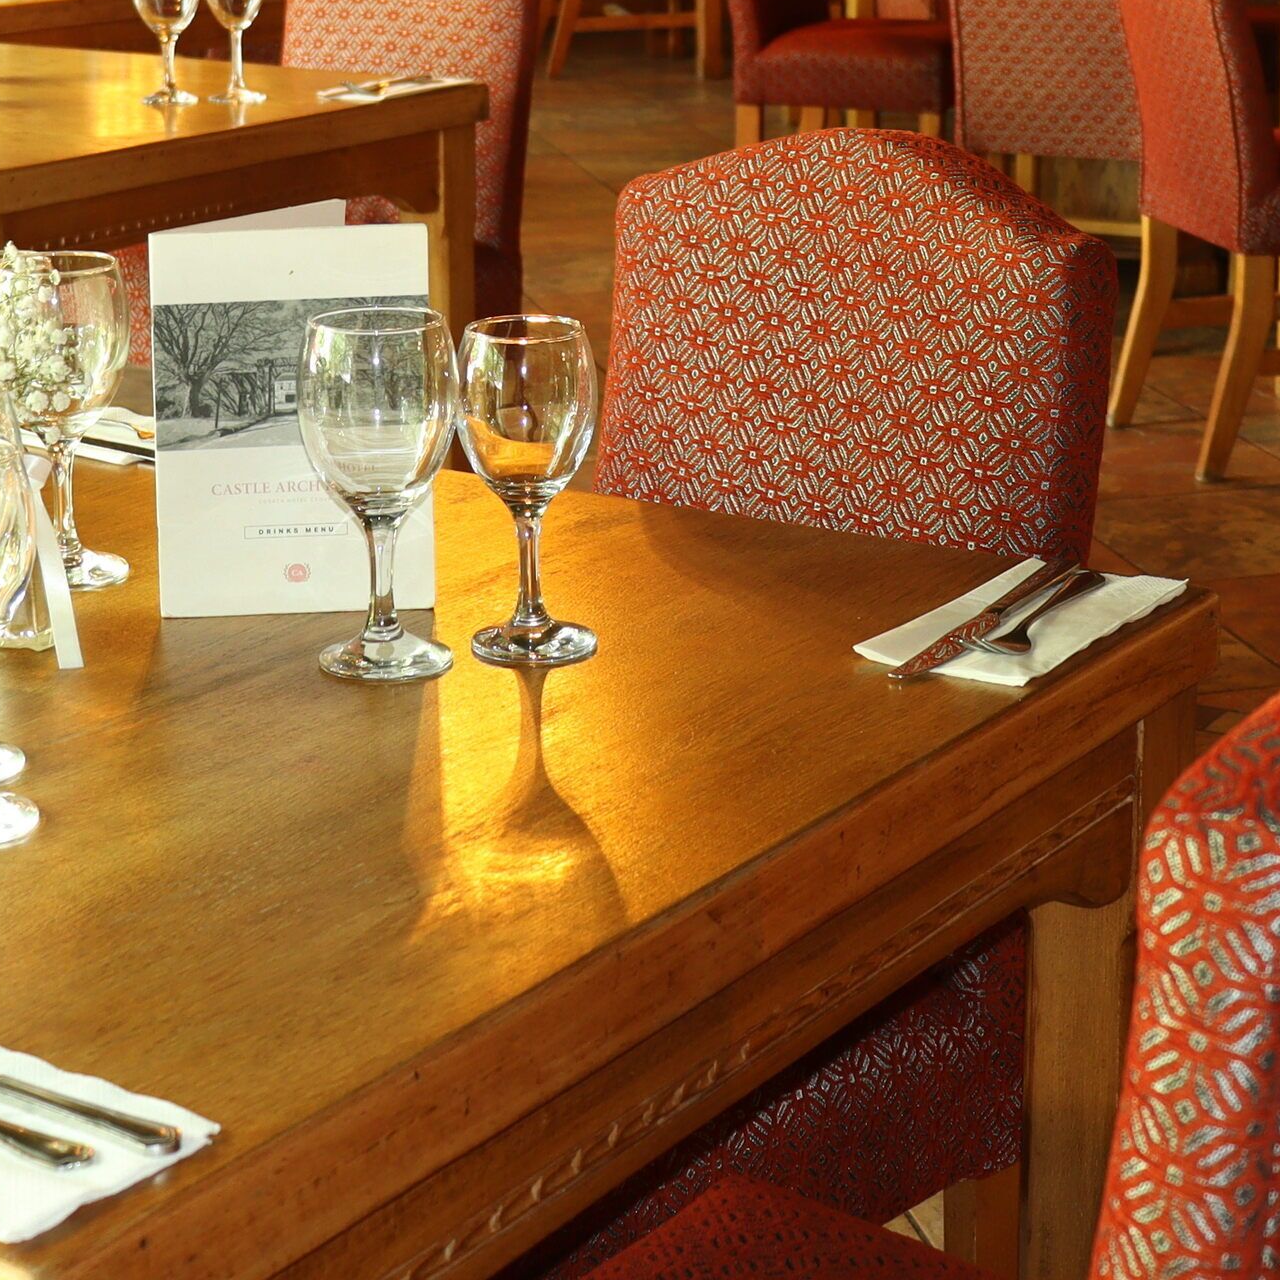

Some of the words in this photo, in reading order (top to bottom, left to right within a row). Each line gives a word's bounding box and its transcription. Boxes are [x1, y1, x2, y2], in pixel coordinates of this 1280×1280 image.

[211, 480, 272, 495] CASTLE
[275, 479, 320, 493] ARCH
[258, 527, 299, 535] DRINKS
